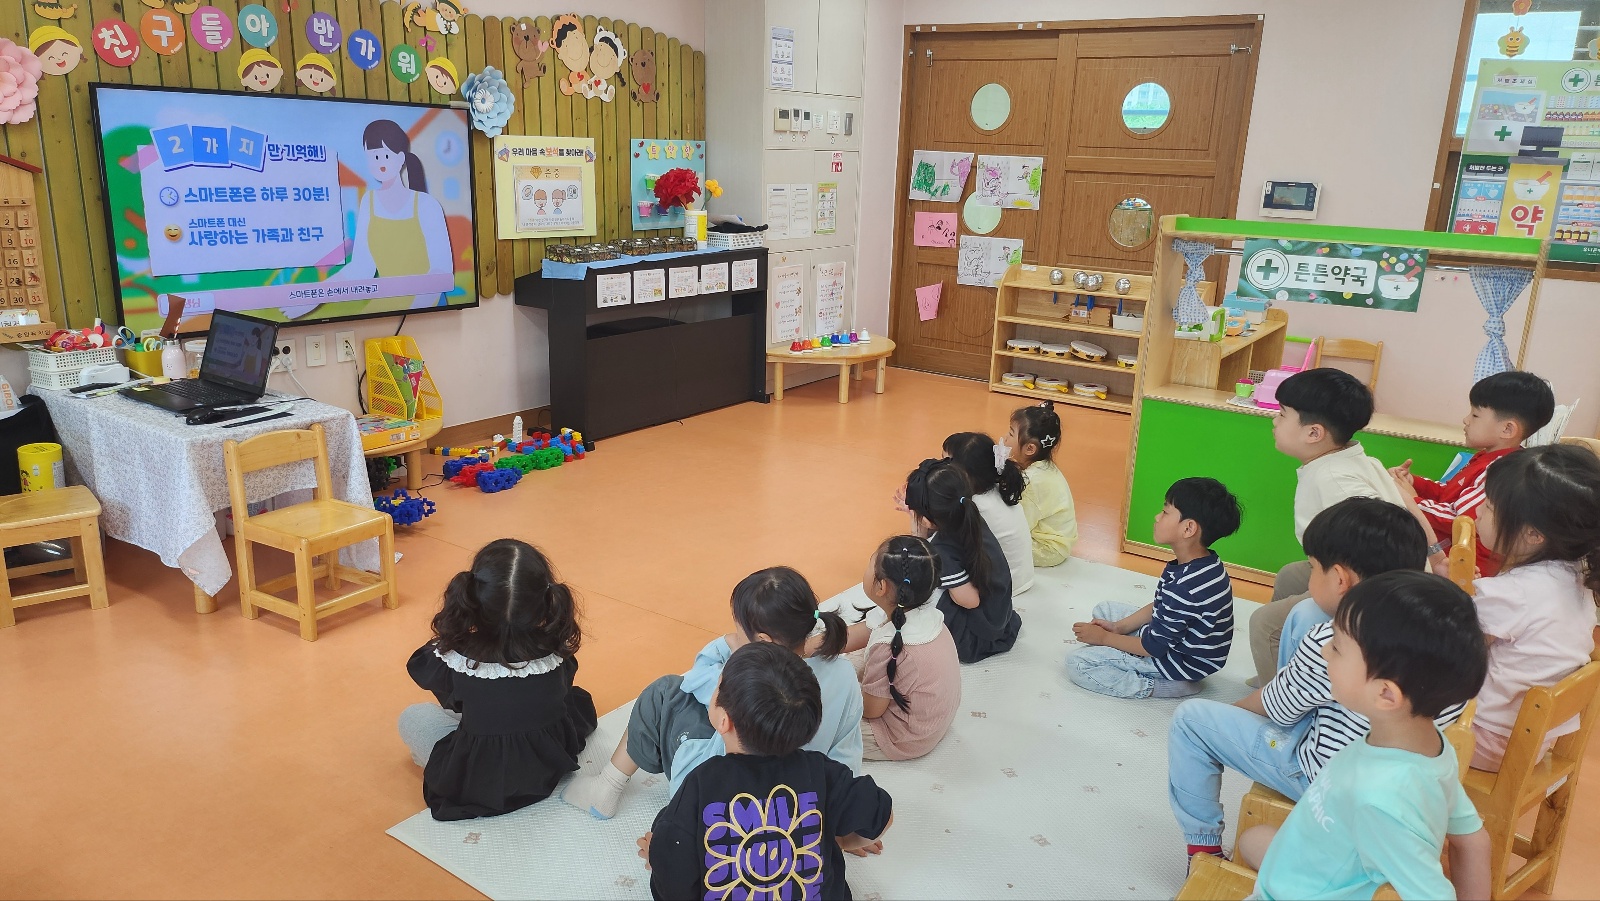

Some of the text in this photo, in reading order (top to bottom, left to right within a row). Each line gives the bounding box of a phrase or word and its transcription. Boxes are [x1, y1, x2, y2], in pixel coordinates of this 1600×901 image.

[314, 18, 416, 75] 반가워
[512, 147, 524, 157] 우리
[525, 147, 537, 156] 마음
[184, 186, 330, 203] 스마트폰은 하루 30분!
[188, 217, 246, 229] 스마트폰 대신
[1510, 205, 1544, 236] 약
[188, 226, 324, 247] 사랑하는 가족과 친구
[1293, 261, 1368, 287] 튼튼약국
[289, 284, 378, 299] 스마트폰은 손에서 내려놓고
[703, 791, 822, 841] SMILE
[704, 832, 824, 884] SMILE
